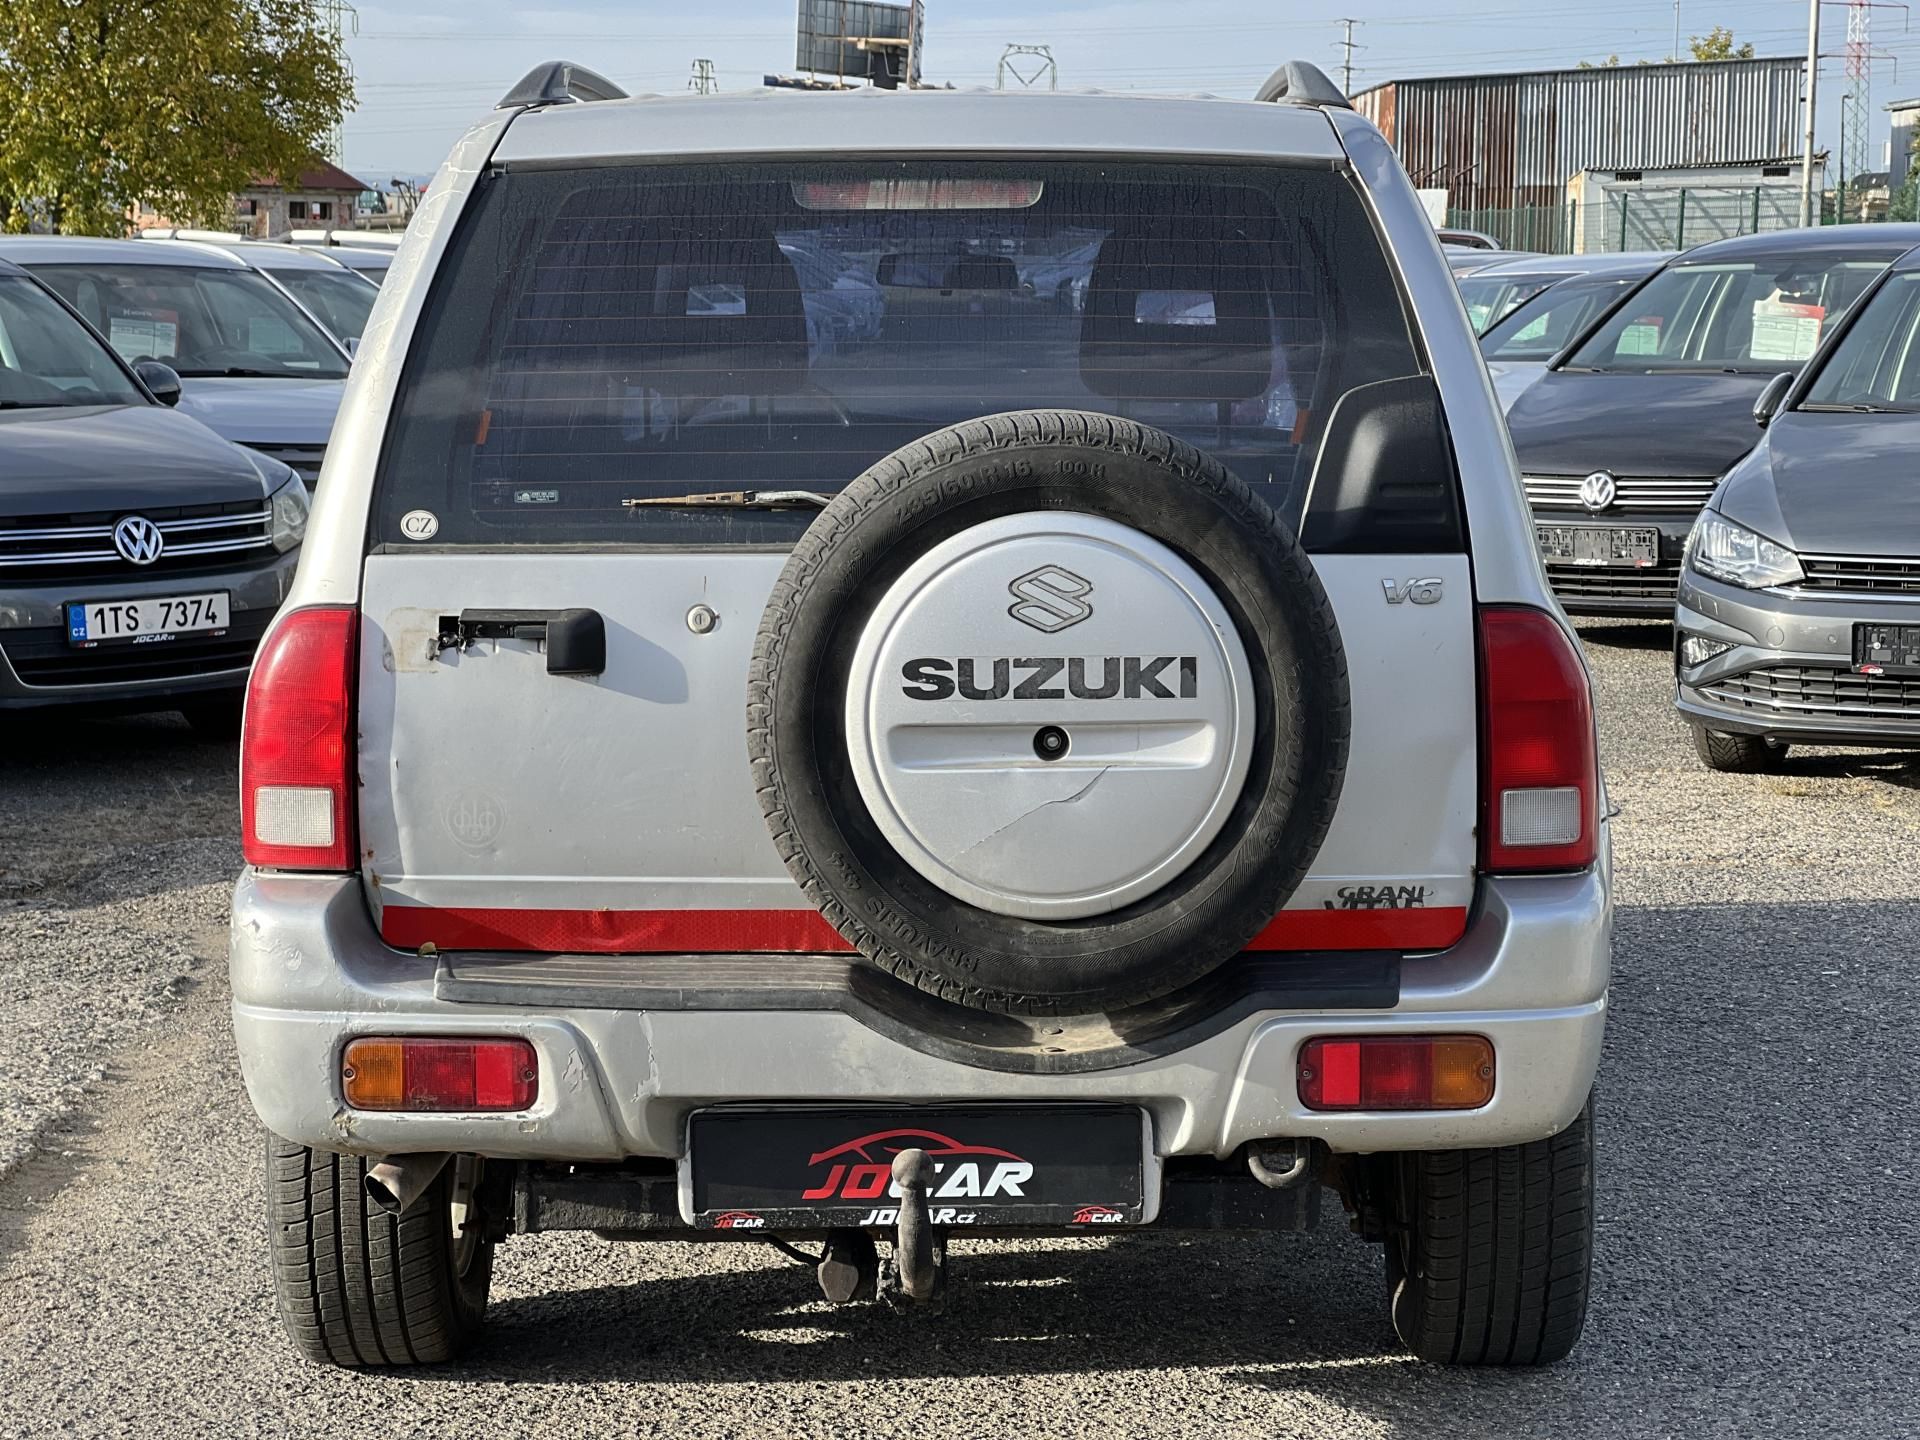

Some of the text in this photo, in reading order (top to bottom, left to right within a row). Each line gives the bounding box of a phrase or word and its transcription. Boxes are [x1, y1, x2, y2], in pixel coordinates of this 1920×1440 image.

[895, 471, 975, 521] 235/60
[1004, 459, 1032, 477] 16
[1054, 459, 1087, 475] 100
[405, 516, 433, 533] CZ
[1381, 577, 1443, 605] V6
[72, 598, 218, 636] CZ 1TS 7374
[901, 657, 1198, 701] SUZUKI
[825, 851, 862, 890] 4x4
[863, 895, 980, 973] BRAVURIS
[714, 1218, 765, 1228] JOCAR
[860, 1208, 977, 1226] JOR.cz
[1072, 1213, 1124, 1223] JOCAR
